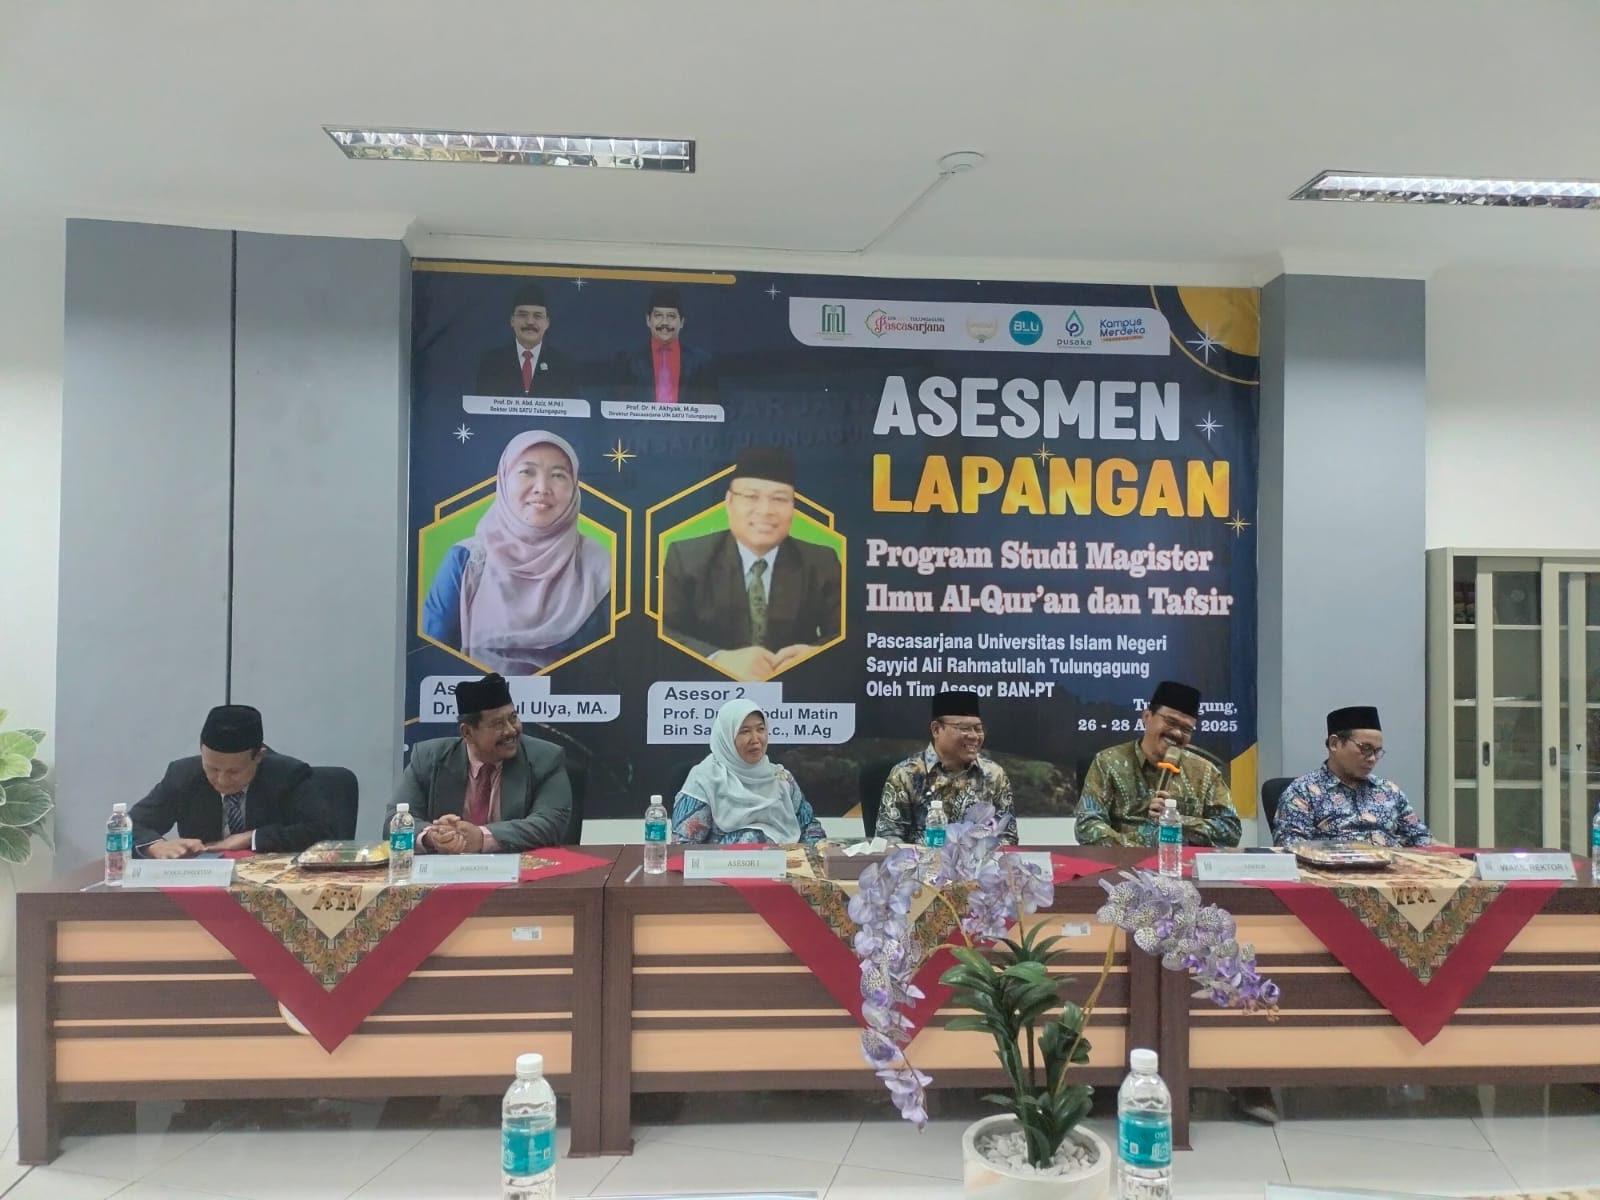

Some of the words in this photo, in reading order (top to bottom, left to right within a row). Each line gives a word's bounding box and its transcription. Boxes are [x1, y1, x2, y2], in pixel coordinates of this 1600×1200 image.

[874, 315, 945, 334] Pascasarjana
[1013, 320, 1039, 332] BLU
[1100, 318, 1142, 329] Kampus
[1100, 326, 1146, 337] Merdeka
[1057, 338, 1092, 347] pusaka
[873, 376, 1180, 440] ASESMEN
[873, 453, 1230, 517] LAPANGAN
[866, 539, 993, 575] Program
[1000, 540, 1078, 571] Studi
[1085, 542, 1214, 577] Magister
[866, 583, 934, 612] Ilmu
[940, 584, 1081, 615] Al-Qur'an
[1087, 586, 1141, 614] dan
[1147, 586, 1234, 616] Tafsir
[866, 632, 973, 653] Pascasarjana
[977, 633, 1066, 650] Universitas
[1069, 634, 1113, 651] Islam
[1117, 635, 1168, 652] Negeri
[866, 656, 918, 677] Sayyid
[922, 657, 943, 673] Ali
[947, 657, 1046, 674] Rahmatullah
[1050, 658, 1150, 678] Tulungagung
[664, 687, 730, 701] Asesor
[735, 687, 746, 700] 2
[866, 680, 902, 697] Oleh
[906, 681, 935, 697] Tim
[997, 681, 1056, 698] BAN-PT
[433, 701, 456, 715] Dr.
[530, 701, 571, 718] Ulya,
[576, 701, 608, 715] MA.
[663, 708, 699, 720] Prof.
[797, 708, 838, 720] Matin
[663, 724, 688, 736] Bin
[793, 724, 832, 739] M.Ag
[1078, 718, 1097, 732] 26
[1111, 719, 1130, 732] 28
[1200, 720, 1238, 732] 2025
[727, 859, 755, 867] ASESOR
